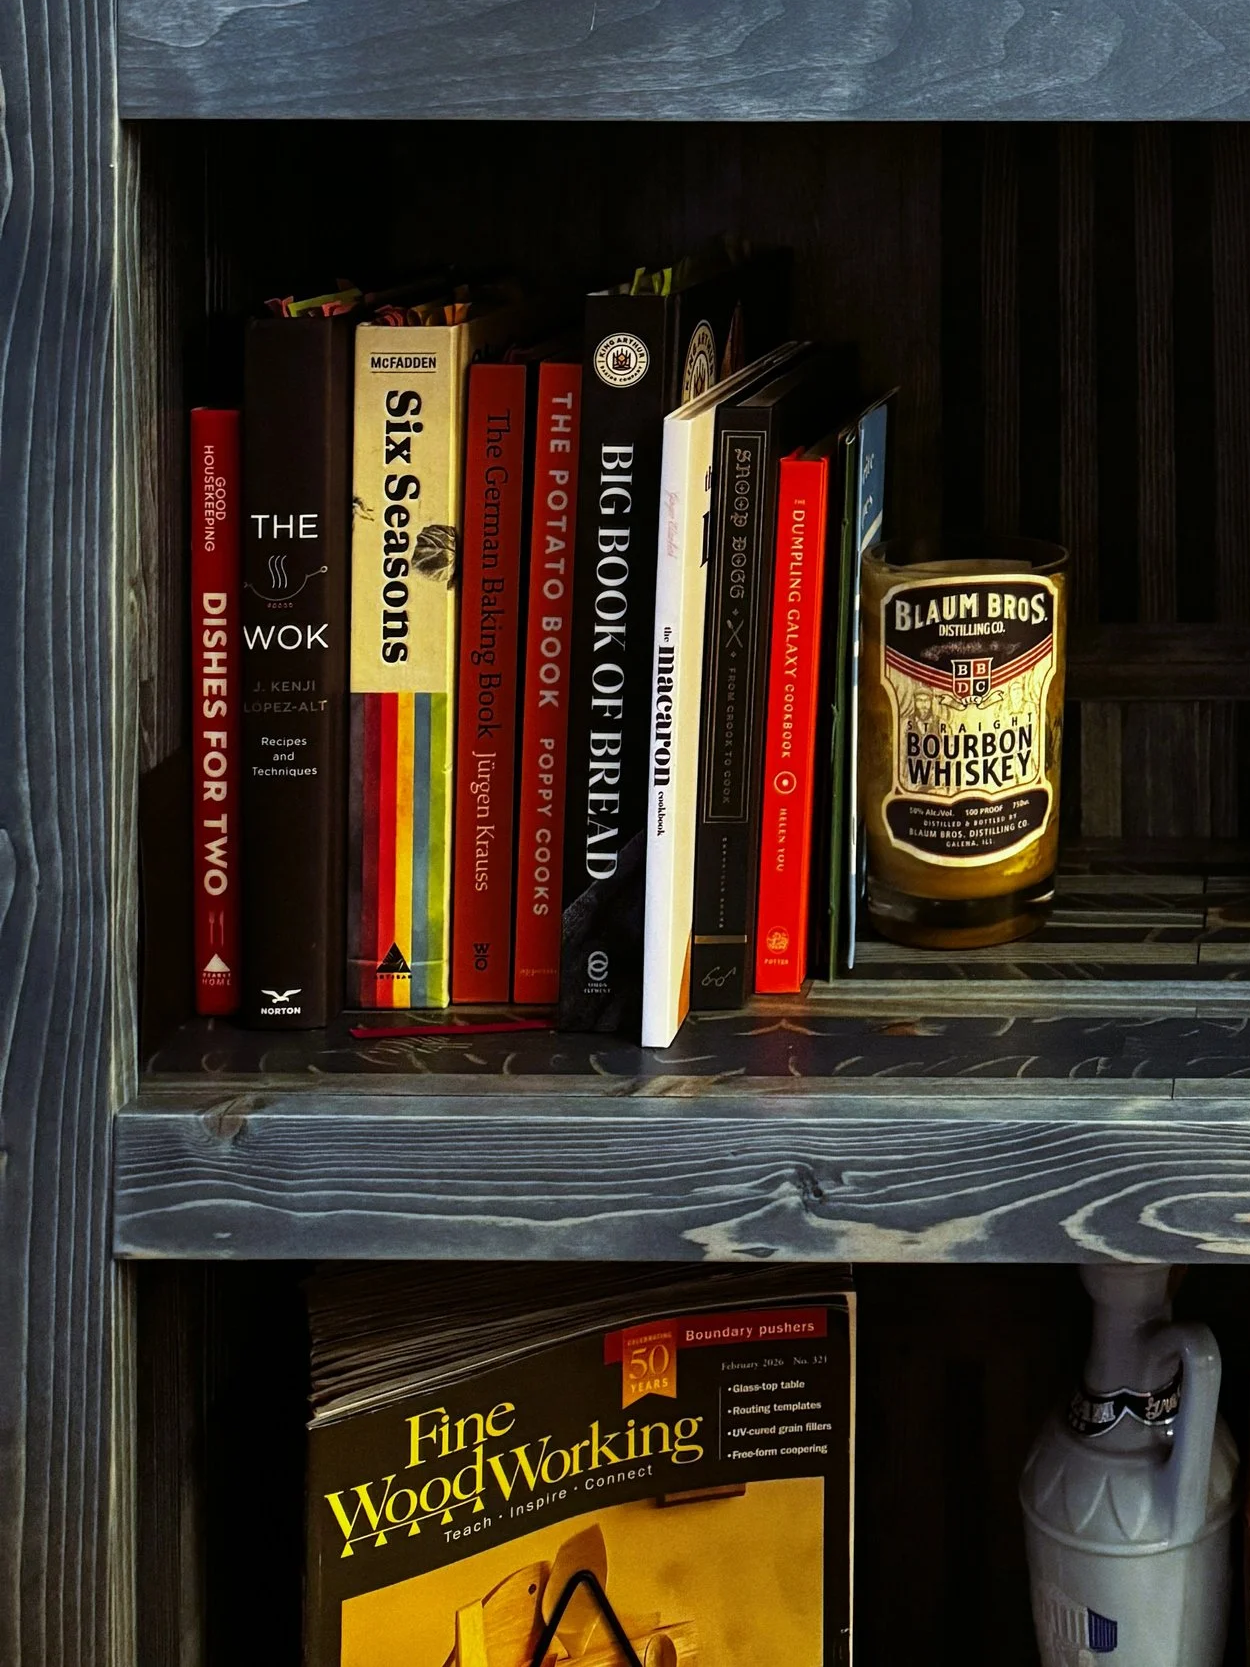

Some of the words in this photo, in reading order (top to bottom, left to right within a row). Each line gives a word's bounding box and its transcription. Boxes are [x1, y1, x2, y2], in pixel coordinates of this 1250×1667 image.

[384, 390, 424, 465] Six
[486, 408, 511, 459] The
[550, 393, 572, 454] THE
[204, 445, 215, 552] HOUSEKEEPING
[215, 477, 226, 520] GOOD
[599, 443, 634, 515] BIG
[251, 514, 318, 539] THE
[481, 465, 509, 570] German
[542, 469, 569, 600] POTATO
[381, 473, 421, 666] Seasons
[593, 526, 630, 652] BOOK
[788, 510, 806, 603] DUMPLING
[243, 623, 329, 650] WOK
[471, 577, 505, 665] Baking
[664, 627, 672, 642] the
[782, 609, 801, 678] GALAXY
[895, 593, 979, 631] BLAUM
[988, 593, 1048, 625] BROS.
[203, 592, 227, 719] DISHES
[540, 617, 562, 708] BOOK
[476, 673, 502, 739] Book
[591, 663, 625, 720] OF
[653, 646, 675, 787] macaron
[781, 683, 795, 758] COOKBOOK
[906, 712, 1035, 733] STRAIGHT
[203, 731, 228, 802] FOR
[252, 767, 317, 777] Techniques
[261, 737, 307, 747] Recipes
[273, 752, 294, 761] and
[907, 723, 1033, 759] BOURBON
[908, 750, 1033, 787] WHISKEY
[470, 750, 496, 820] Jürgen
[537, 739, 554, 817] POPPY
[586, 730, 622, 880] BREAD
[657, 791, 666, 836] cookbook
[203, 813, 228, 896] TWO
[475, 825, 495, 892] Krauss
[533, 828, 551, 916] COOKS
[260, 1006, 301, 1015] NORTON
[629, 1344, 669, 1379] 50
[685, 1326, 753, 1341] Boundary
[759, 1321, 815, 1336] pushers
[630, 1378, 669, 1394] YEARS
[781, 1380, 805, 1389] table
[404, 1401, 516, 1471] Fine
[444, 1514, 493, 1543] Teach
[509, 1486, 568, 1519] Inspire
[584, 1464, 654, 1492] Connect
